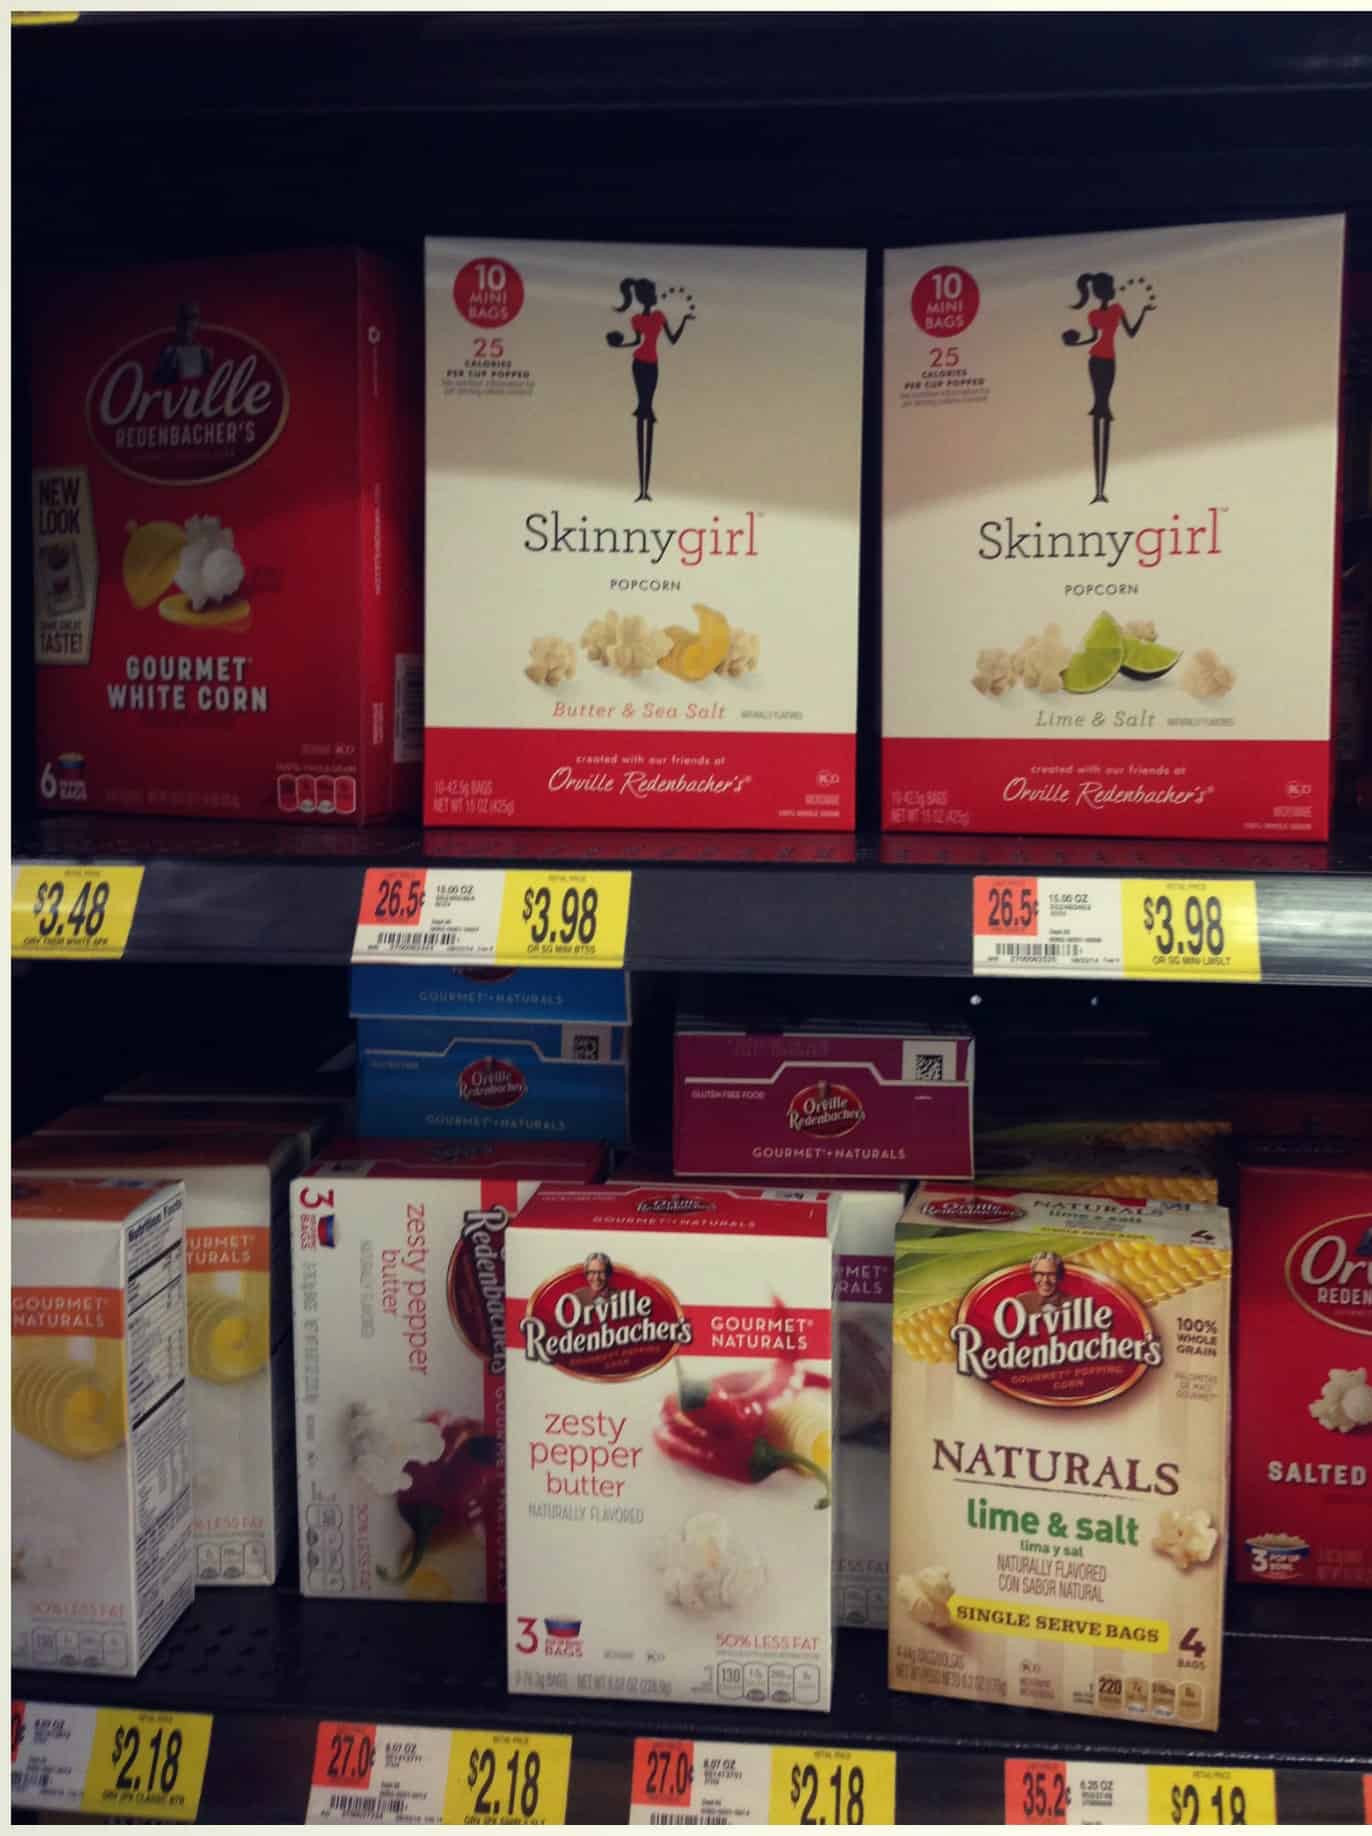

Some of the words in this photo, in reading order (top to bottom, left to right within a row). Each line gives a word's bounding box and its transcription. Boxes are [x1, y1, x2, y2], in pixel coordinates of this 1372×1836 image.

[475, 264, 506, 291] 10
[931, 273, 962, 299] 10
[470, 292, 508, 305] MINI
[926, 300, 963, 315] MINI
[468, 306, 509, 321] BAGS
[925, 314, 965, 330] BAGS
[473, 338, 505, 359] 25
[930, 347, 960, 367] 25
[921, 369, 968, 379] CALORIES
[98, 356, 272, 426] Orville
[115, 422, 256, 449] REDENBACHER'S
[40, 478, 80, 505] NEW
[40, 510, 80, 535] LOOK
[524, 511, 760, 567] Skinnygirl
[978, 507, 1222, 568] Skinnygirl
[610, 578, 681, 593] POPCORN
[1064, 583, 1139, 597] POPCORN
[126, 656, 248, 681] GOURMET
[107, 684, 186, 711] WHITE
[197, 685, 268, 713] CORN
[552, 702, 616, 720] Butter
[622, 703, 636, 719] &
[642, 703, 678, 720] Sea
[686, 702, 726, 721] Salt
[1035, 710, 1084, 728] Lime
[1091, 711, 1106, 727] &
[1113, 709, 1156, 728] Salt
[576, 754, 618, 766] created
[622, 754, 644, 766] with
[648, 757, 668, 766] our
[671, 754, 711, 766] friends
[1030, 764, 1073, 775] created
[1077, 764, 1101, 775] with
[1128, 764, 1171, 776] friends
[40, 762, 57, 799] 6
[547, 766, 614, 793] Orville
[619, 772, 746, 799] Redenbacher's
[1003, 776, 1069, 803] Orville
[1075, 781, 1207, 809] Redenbacher's
[33, 880, 110, 937] $3.48
[522, 886, 599, 944] $3.98
[1143, 894, 1225, 955] $3.98
[803, 1096, 849, 1115] Orville
[752, 1147, 821, 1160] GOURMET
[835, 1148, 905, 1160] NATURALS
[299, 1187, 334, 1209] 3
[1034, 1200, 1163, 1217] NATURALS
[190, 1234, 250, 1249] URMET
[402, 1202, 429, 1272] zesty
[187, 1249, 250, 1265] TURALS
[381, 1249, 400, 1316] butter
[13, 1297, 103, 1312] GOURMET
[555, 1290, 652, 1329] Orville
[13, 1314, 104, 1329] NATURALS
[402, 1279, 429, 1376] pepper
[711, 1317, 812, 1332] GOURMET
[994, 1297, 1113, 1340] Orville
[1177, 1317, 1217, 1334] 100%
[520, 1316, 693, 1365] Redenbacher's
[712, 1334, 808, 1350] NATURALS
[1176, 1345, 1217, 1357] GRAIN
[1177, 1334, 1217, 1346] WHOLE
[951, 1326, 1164, 1381] Redenbacher's
[544, 1410, 627, 1443] zesty
[530, 1439, 642, 1473] pepper
[933, 1438, 1180, 1496] NATURALS
[546, 1472, 624, 1498] butter
[1268, 1461, 1367, 1486] SALTED
[528, 1503, 587, 1520] NATURALLY
[590, 1507, 644, 1524] FLAVORED
[967, 1498, 1040, 1535] lime
[1048, 1511, 1068, 1539] &
[1076, 1514, 1139, 1546] salt
[1020, 1539, 1050, 1554] lima
[1064, 1544, 1084, 1557] sal
[1251, 1549, 1268, 1572] 3
[997, 1554, 1052, 1577] NATURALLY
[1055, 1561, 1107, 1583] FLAVORED
[998, 1574, 1021, 1593] CON
[1022, 1577, 1056, 1596] SABOR
[1058, 1582, 1105, 1603] NATURAL
[515, 1617, 539, 1654] 3
[956, 1605, 1031, 1628] SINGLE
[1035, 1616, 1102, 1637] SERVE
[1105, 1624, 1160, 1643] BAGS
[792, 1636, 819, 1651] FAT
[1178, 1627, 1206, 1658] 4
[1177, 1659, 1207, 1671] BAGS
[1099, 1677, 1122, 1695] 220
[112, 1725, 183, 1793] $2.18
[468, 1747, 540, 1817] $2.18
[791, 1762, 864, 1825] $2.18
[1100, 1781, 1113, 1791] OZ
[1171, 1784, 1246, 1825] $218
